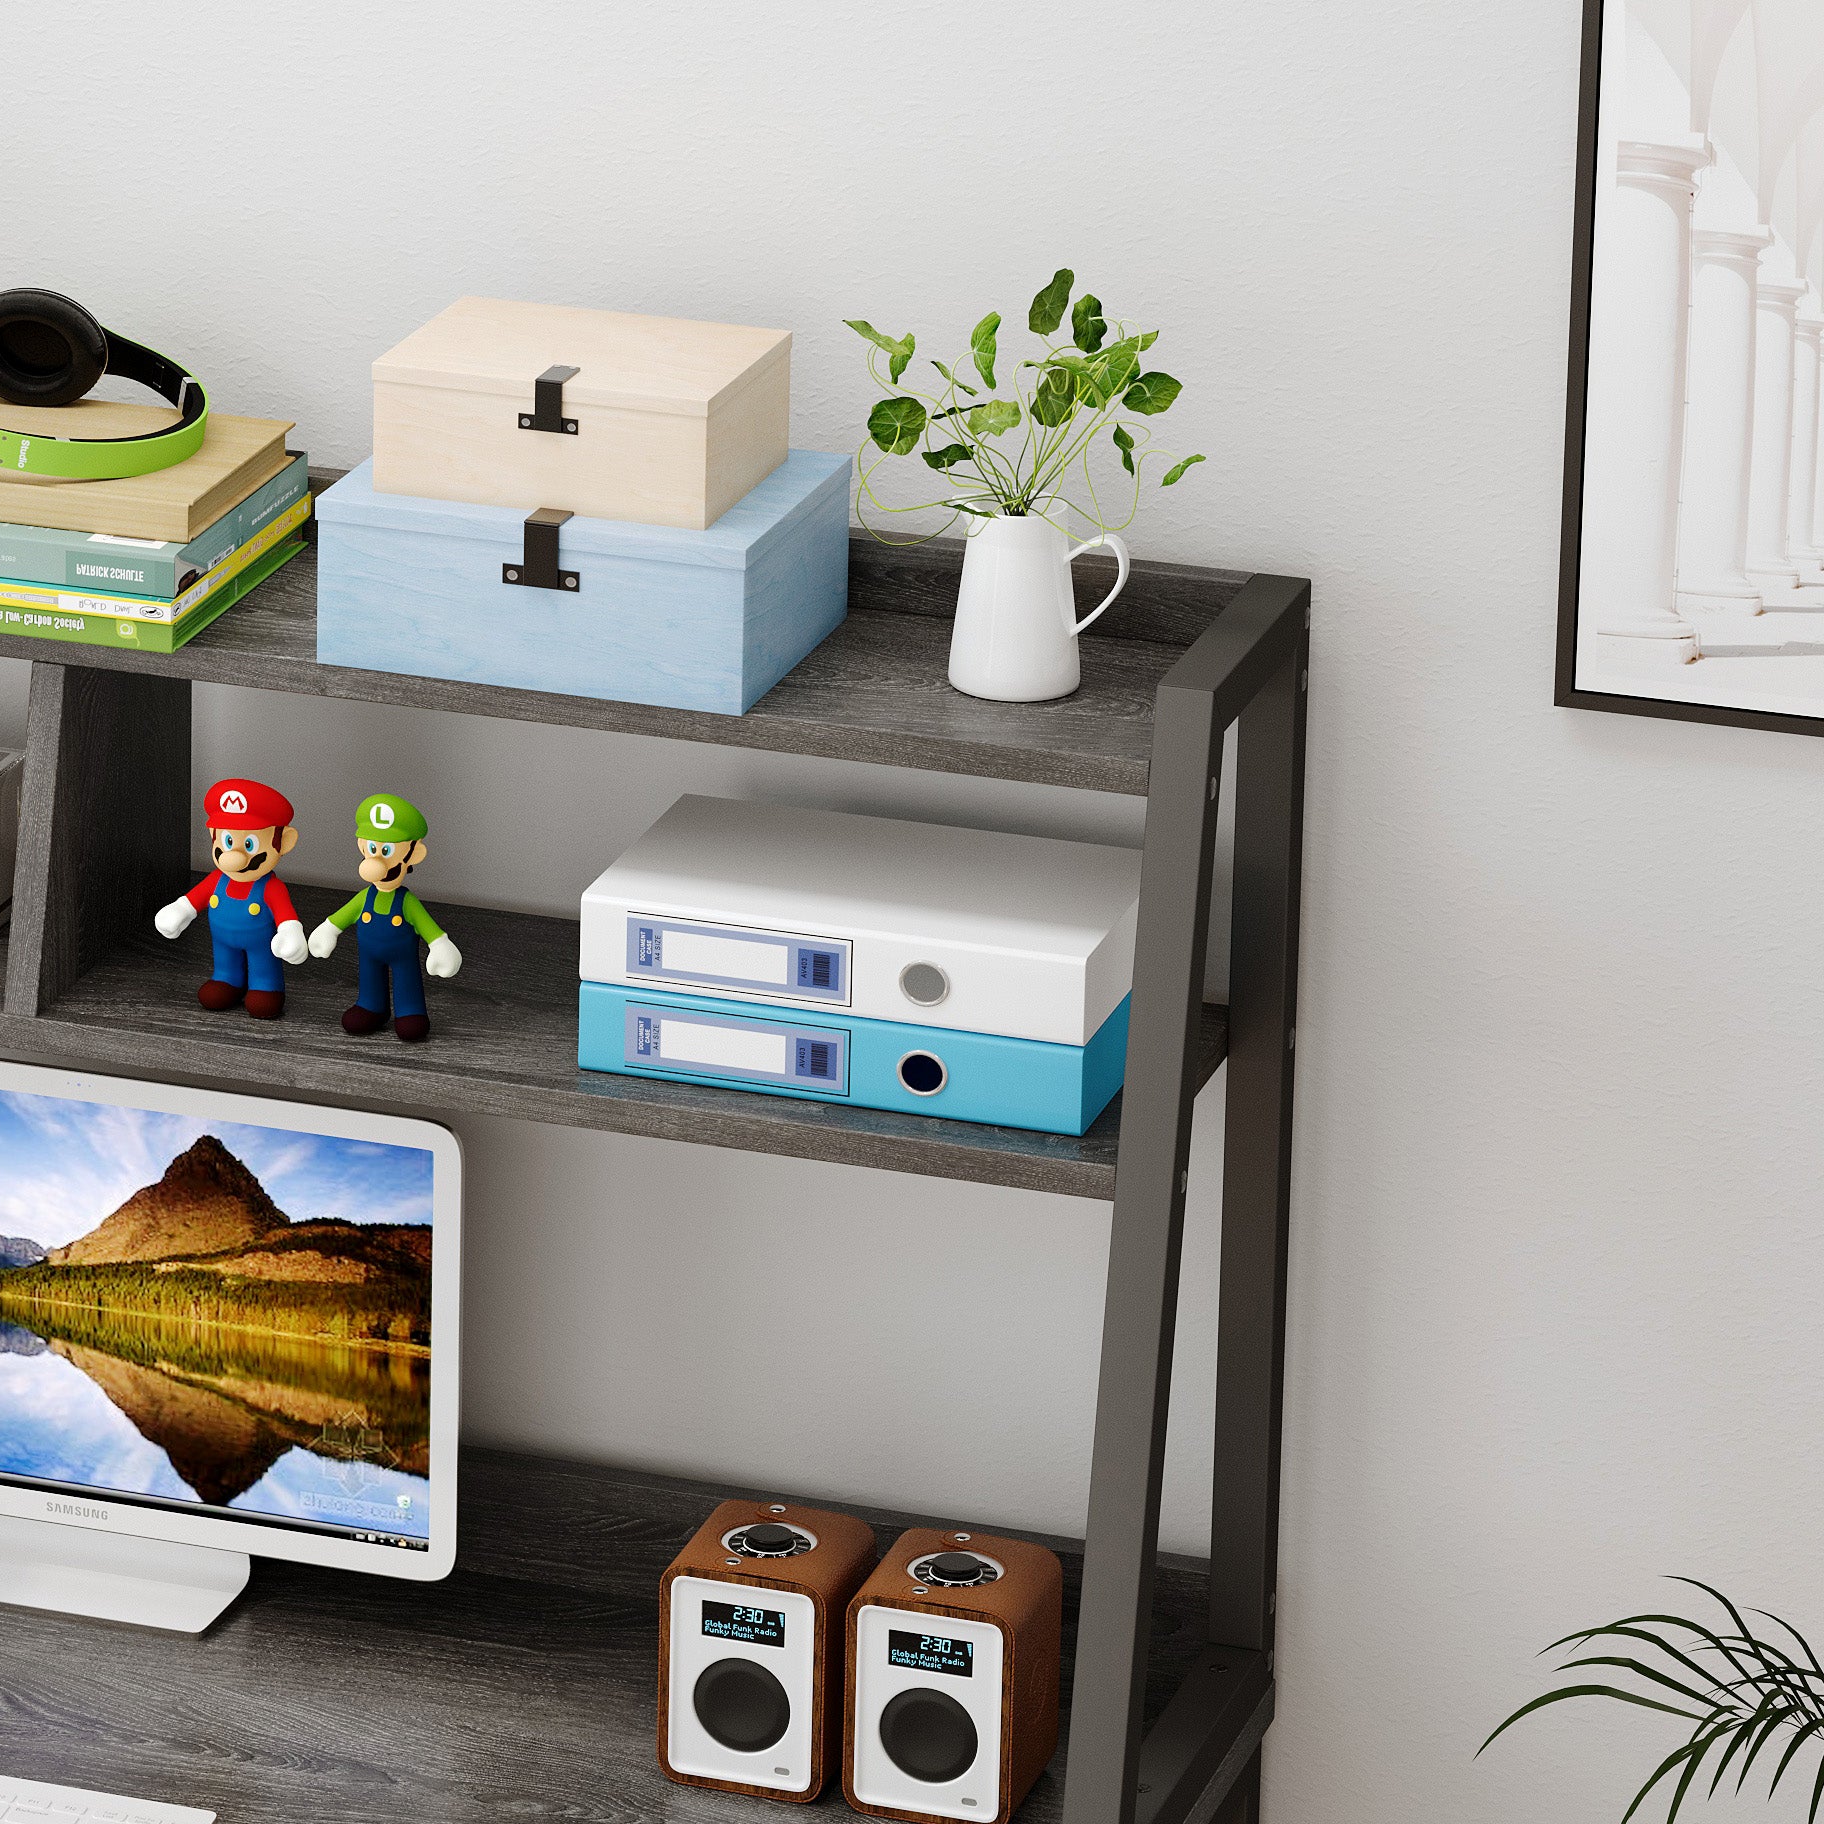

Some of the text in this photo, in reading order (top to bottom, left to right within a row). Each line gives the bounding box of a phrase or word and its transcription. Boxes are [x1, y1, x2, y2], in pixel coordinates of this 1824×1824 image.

[17, 439, 31, 469] Studio
[221, 795, 245, 812] M
[375, 806, 390, 825] L
[639, 930, 647, 962] DOCUMENT
[655, 951, 661, 961] A4
[653, 1041, 659, 1051] A4
[46, 1501, 109, 1520] SAMSUNG
[732, 1606, 764, 1624] 2:30
[704, 1619, 777, 1637] Global Funk Radio
[704, 1625, 755, 1640] Funky Music
[920, 1636, 952, 1654] 2:30
[891, 1649, 965, 1667] Global Funk Radio
[891, 1655, 942, 1670] Funky Music
